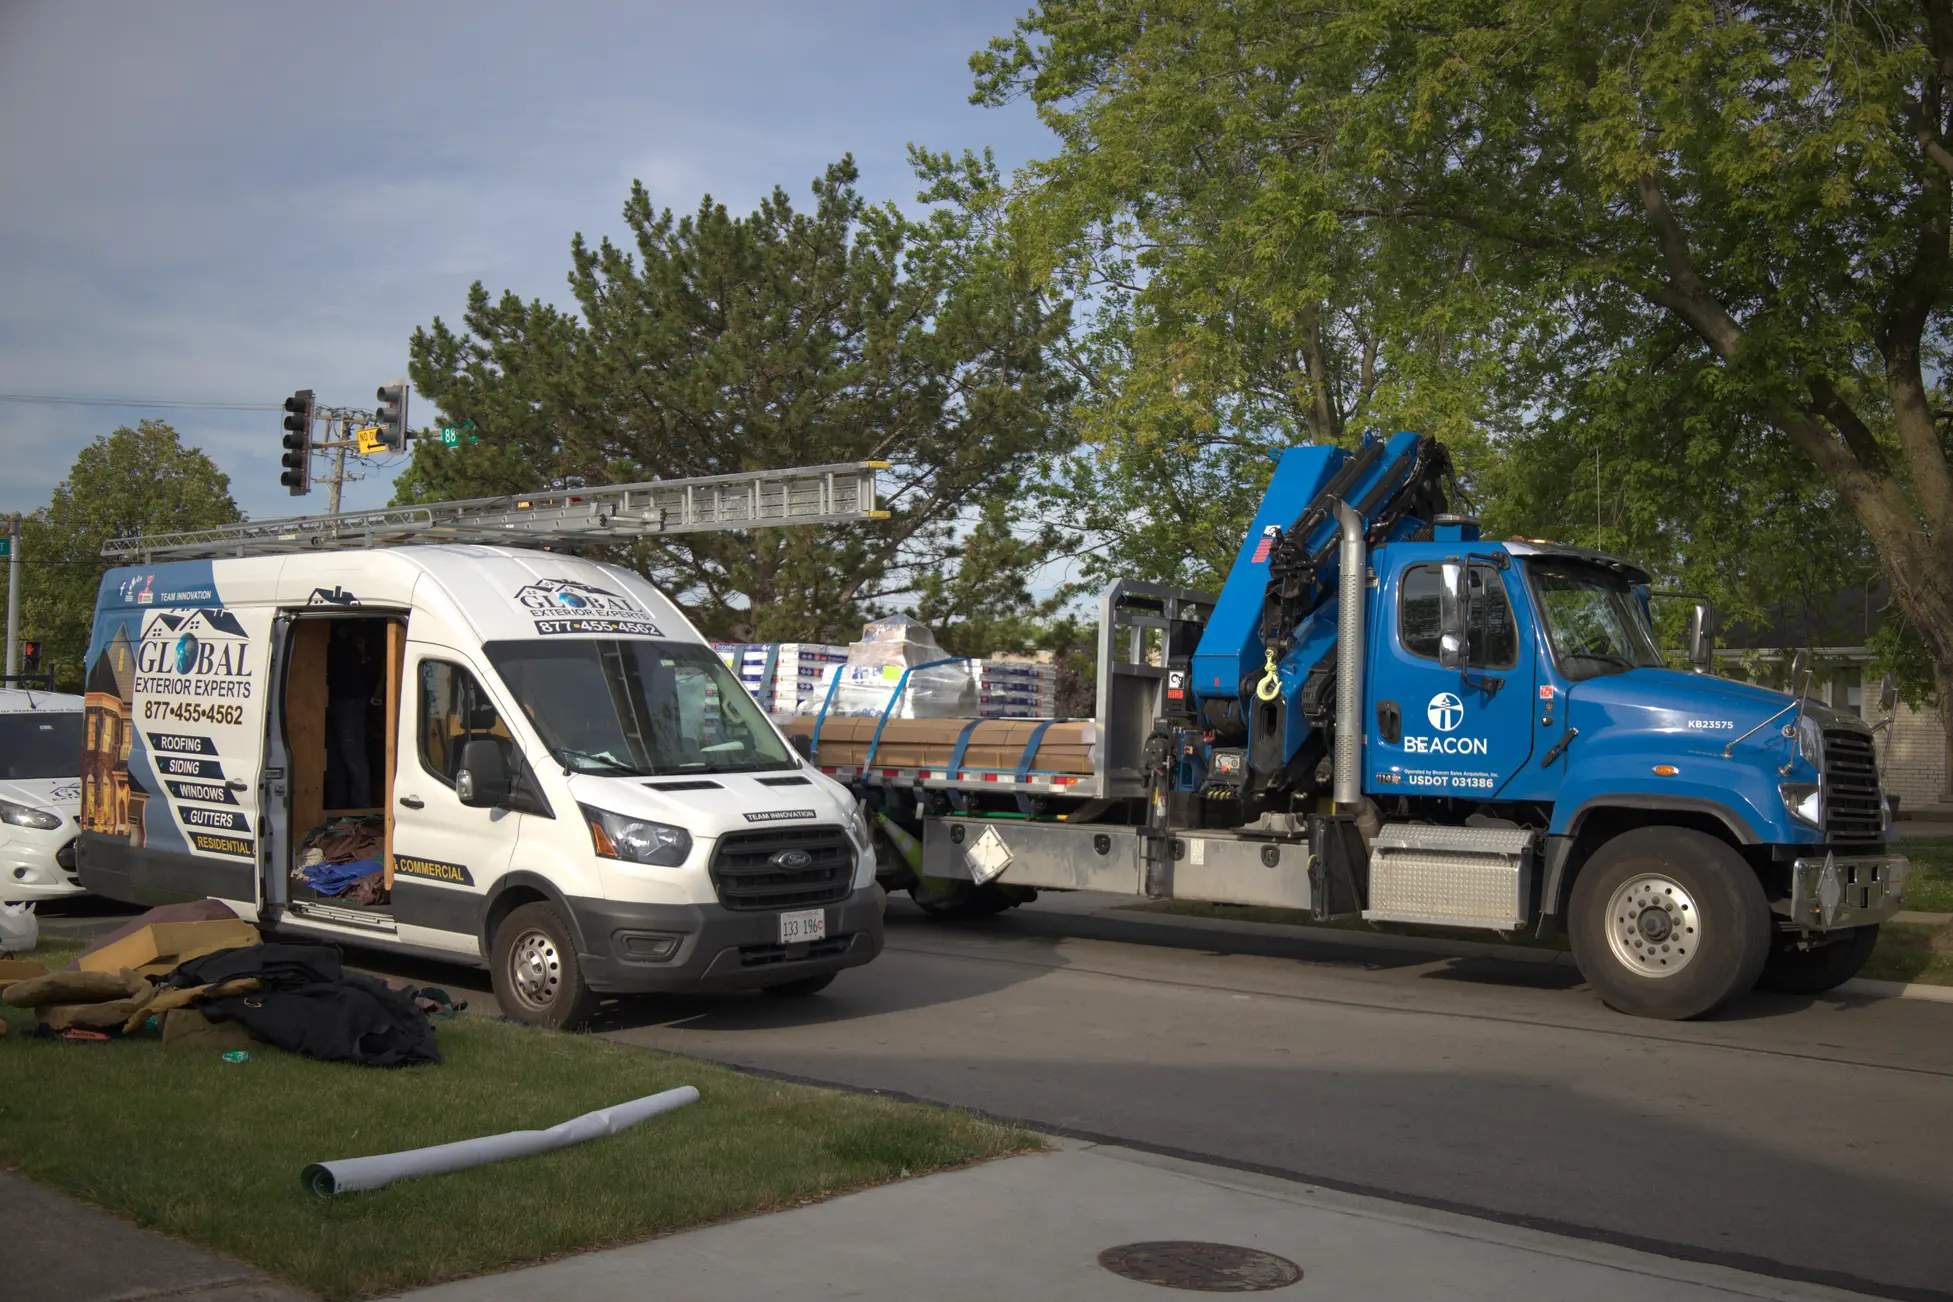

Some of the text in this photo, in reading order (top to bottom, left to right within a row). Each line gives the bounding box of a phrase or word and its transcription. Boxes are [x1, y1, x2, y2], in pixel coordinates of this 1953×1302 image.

[360, 431, 369, 441] NO
[161, 592, 176, 601] TEAM
[177, 590, 212, 600] INNOVATION
[520, 592, 643, 612] GLOBAL
[530, 608, 650, 620] EXTERIOR EXPERTS
[138, 632, 252, 677] GLOBAL
[135, 677, 251, 698] EXTERIOR EXPERTS
[1168, 689, 1184, 699] HIAB
[1688, 720, 1734, 729] KB23575
[161, 736, 201, 752] ROOFING
[1404, 736, 1488, 755] BEACON
[169, 759, 200, 774] SIDING
[1409, 775, 1494, 788] USDOT 031386
[180, 784, 224, 801] WINDOWS
[190, 810, 233, 827] GUTTERS
[747, 810, 815, 821] TEAM INNOVATION
[197, 835, 251, 855] RESIDENTIAL
[400, 859, 464, 881] COMMERCIAL
[784, 920, 798, 936] 133
